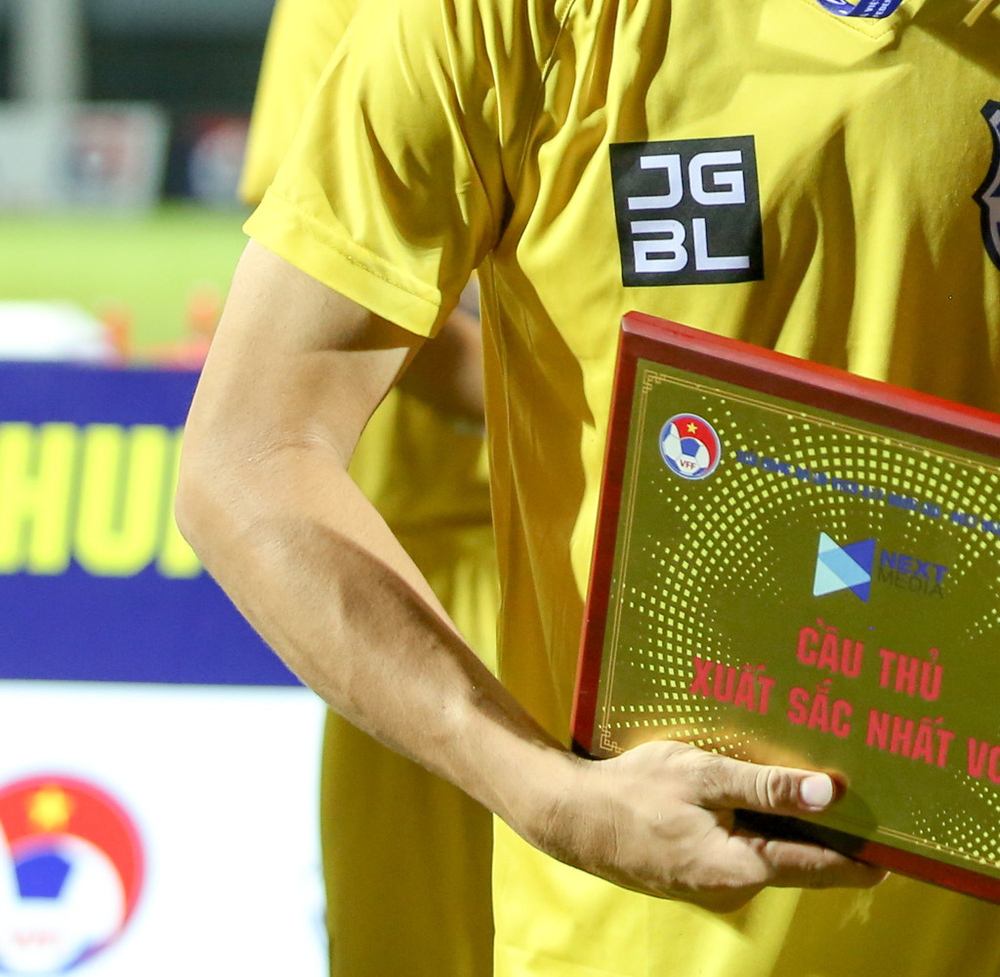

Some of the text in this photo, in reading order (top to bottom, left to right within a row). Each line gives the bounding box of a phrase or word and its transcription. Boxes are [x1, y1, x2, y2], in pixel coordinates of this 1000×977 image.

[628, 150, 746, 210] JG
[630, 218, 750, 273] BL
[877, 565, 944, 600] MEDIA
[881, 550, 949, 583] NEXT
[796, 617, 943, 701] CẦU THỦ
[690, 656, 776, 715] XUẤT
[787, 678, 853, 739] SẮC
[866, 709, 955, 768] NHẤT
